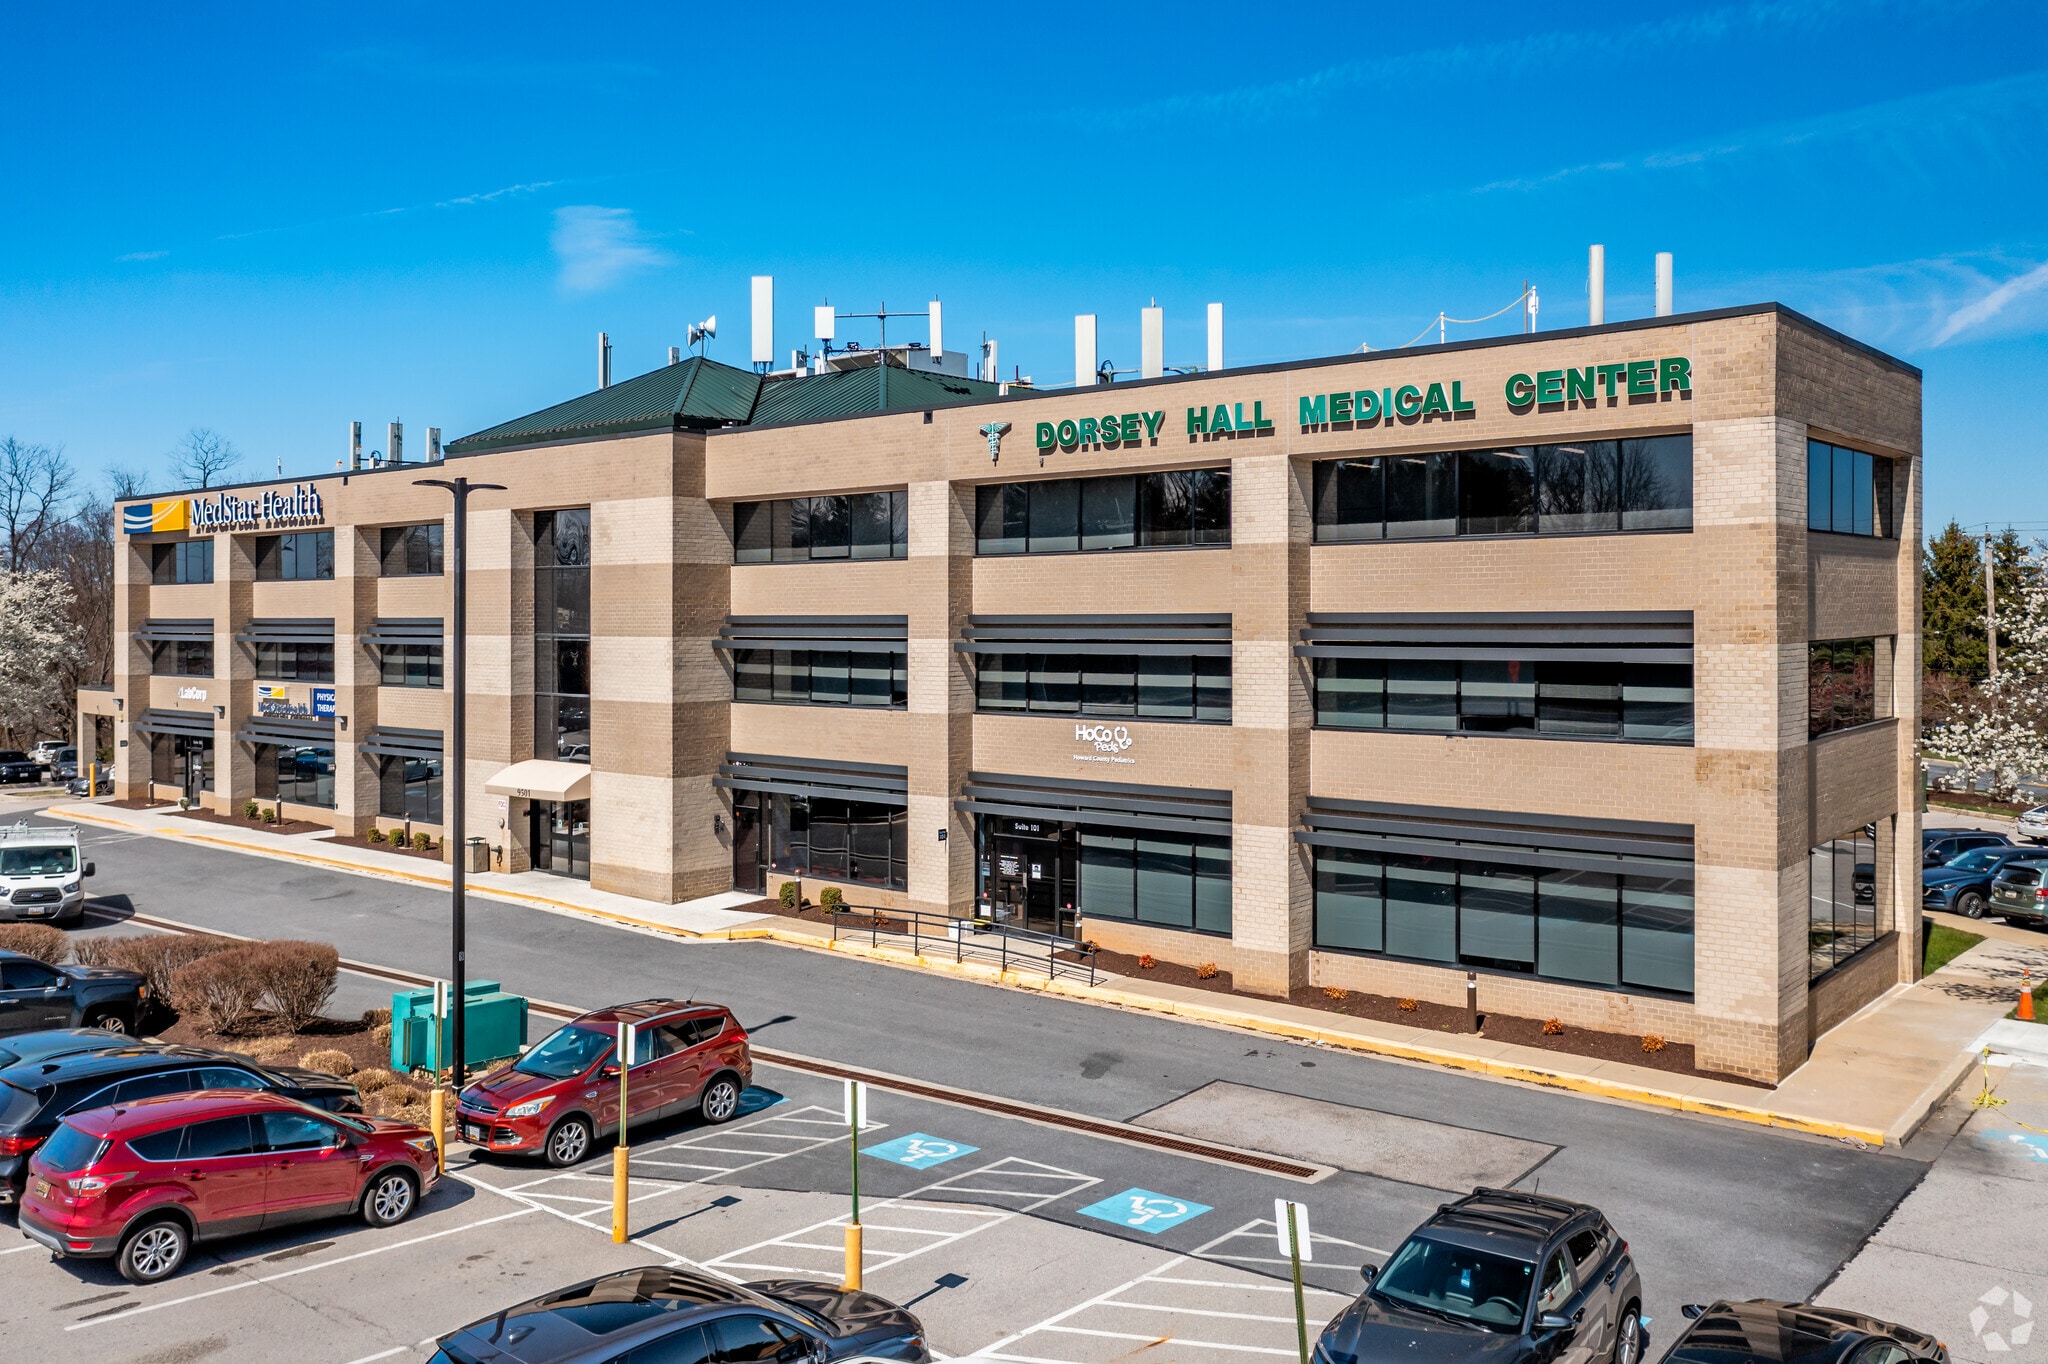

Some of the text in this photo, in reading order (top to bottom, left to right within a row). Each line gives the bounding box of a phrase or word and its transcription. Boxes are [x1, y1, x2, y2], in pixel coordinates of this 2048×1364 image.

[1036, 356, 1692, 449] DORSEY HALL MEDICAL CENTER
[190, 483, 321, 526] MedStar Health
[1075, 724, 1112, 742] HoCo
[1094, 741, 1119, 753] Peds
[516, 788, 530, 797] 9501
[1014, 822, 1040, 832] Suite 101
